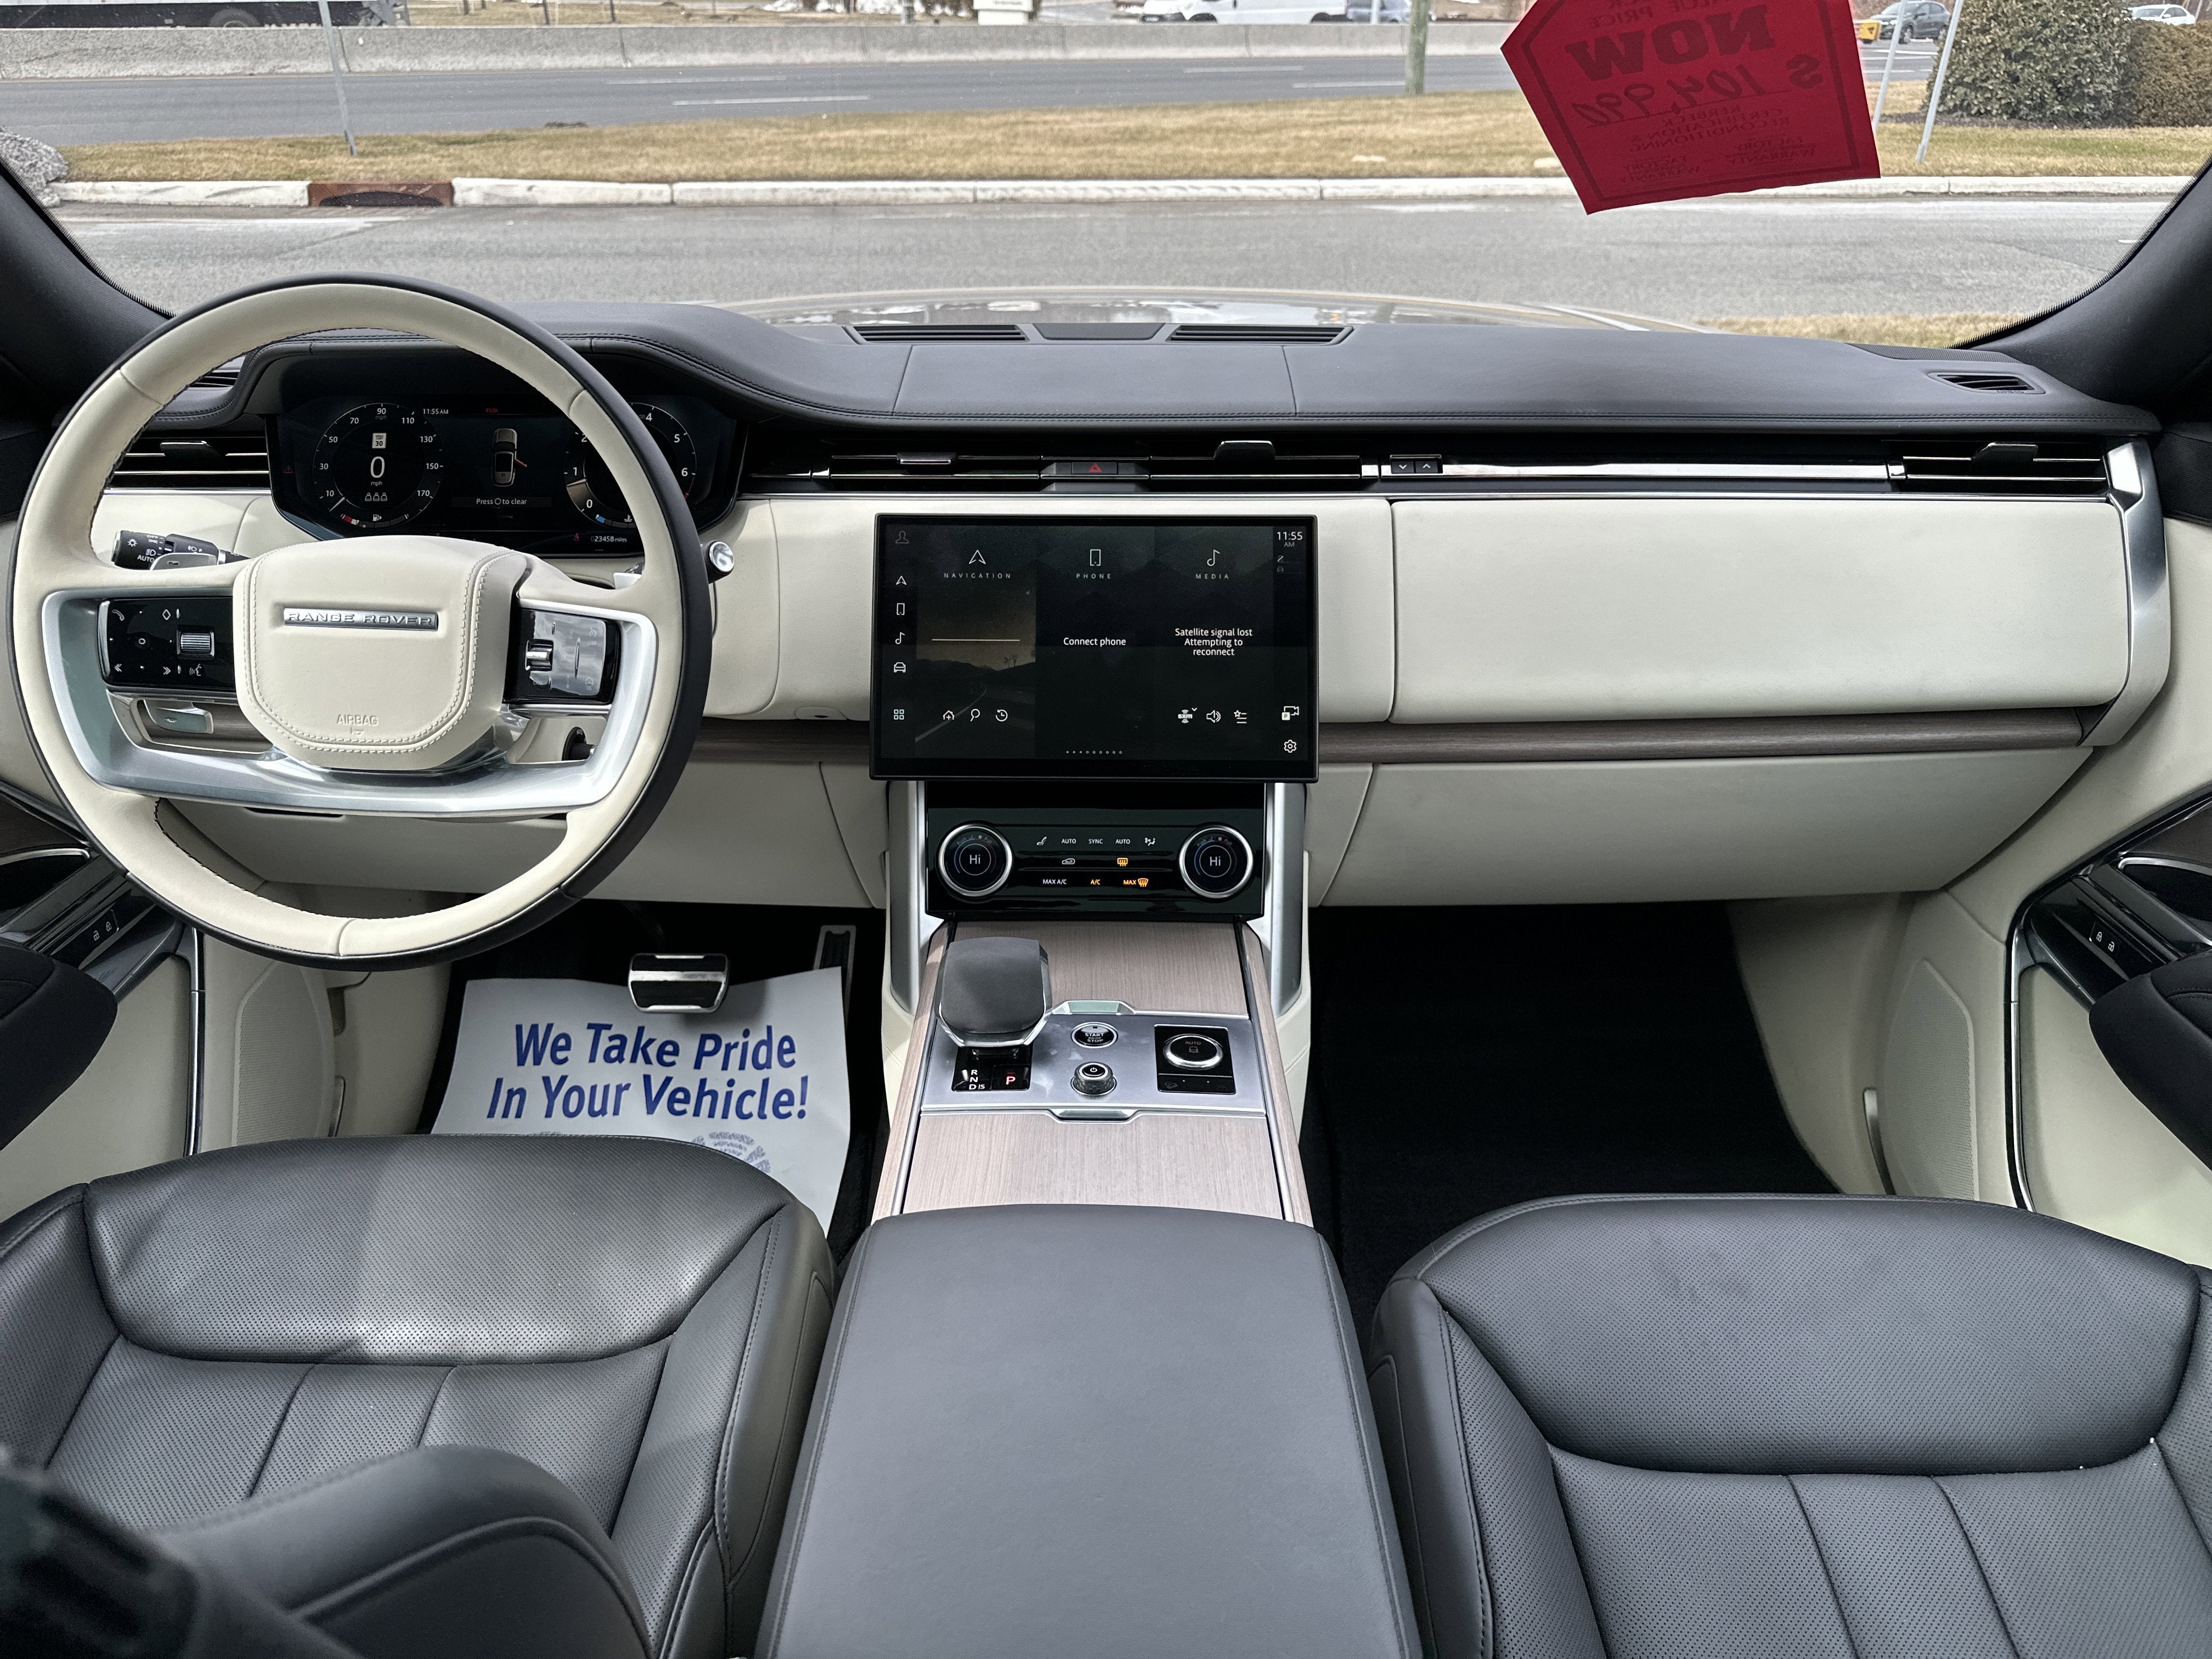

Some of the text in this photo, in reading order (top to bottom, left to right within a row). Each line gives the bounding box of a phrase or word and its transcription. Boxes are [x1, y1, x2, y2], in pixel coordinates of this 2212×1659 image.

[646, 413, 653, 422] 4
[674, 434, 680, 443] 5
[370, 456, 385, 478] 0
[573, 467, 578, 476] 1
[681, 468, 688, 477] 6
[586, 499, 593, 508] 0
[1277, 532, 1303, 541] 11:55
[287, 613, 433, 625] RANGE ROVER
[1175, 628, 1252, 638] Satellite signal lost
[1063, 637, 1126, 647] Connect phone
[1184, 638, 1233, 647] Attempting
[1193, 648, 1235, 656] reconnect
[337, 714, 379, 726] AIRBAG
[969, 854, 981, 865] Hi
[1210, 856, 1221, 867] Hi
[515, 1023, 797, 1071] We Take Pride
[1006, 1076, 1016, 1085] P
[486, 1074, 809, 1120] In Your Vehicle!
